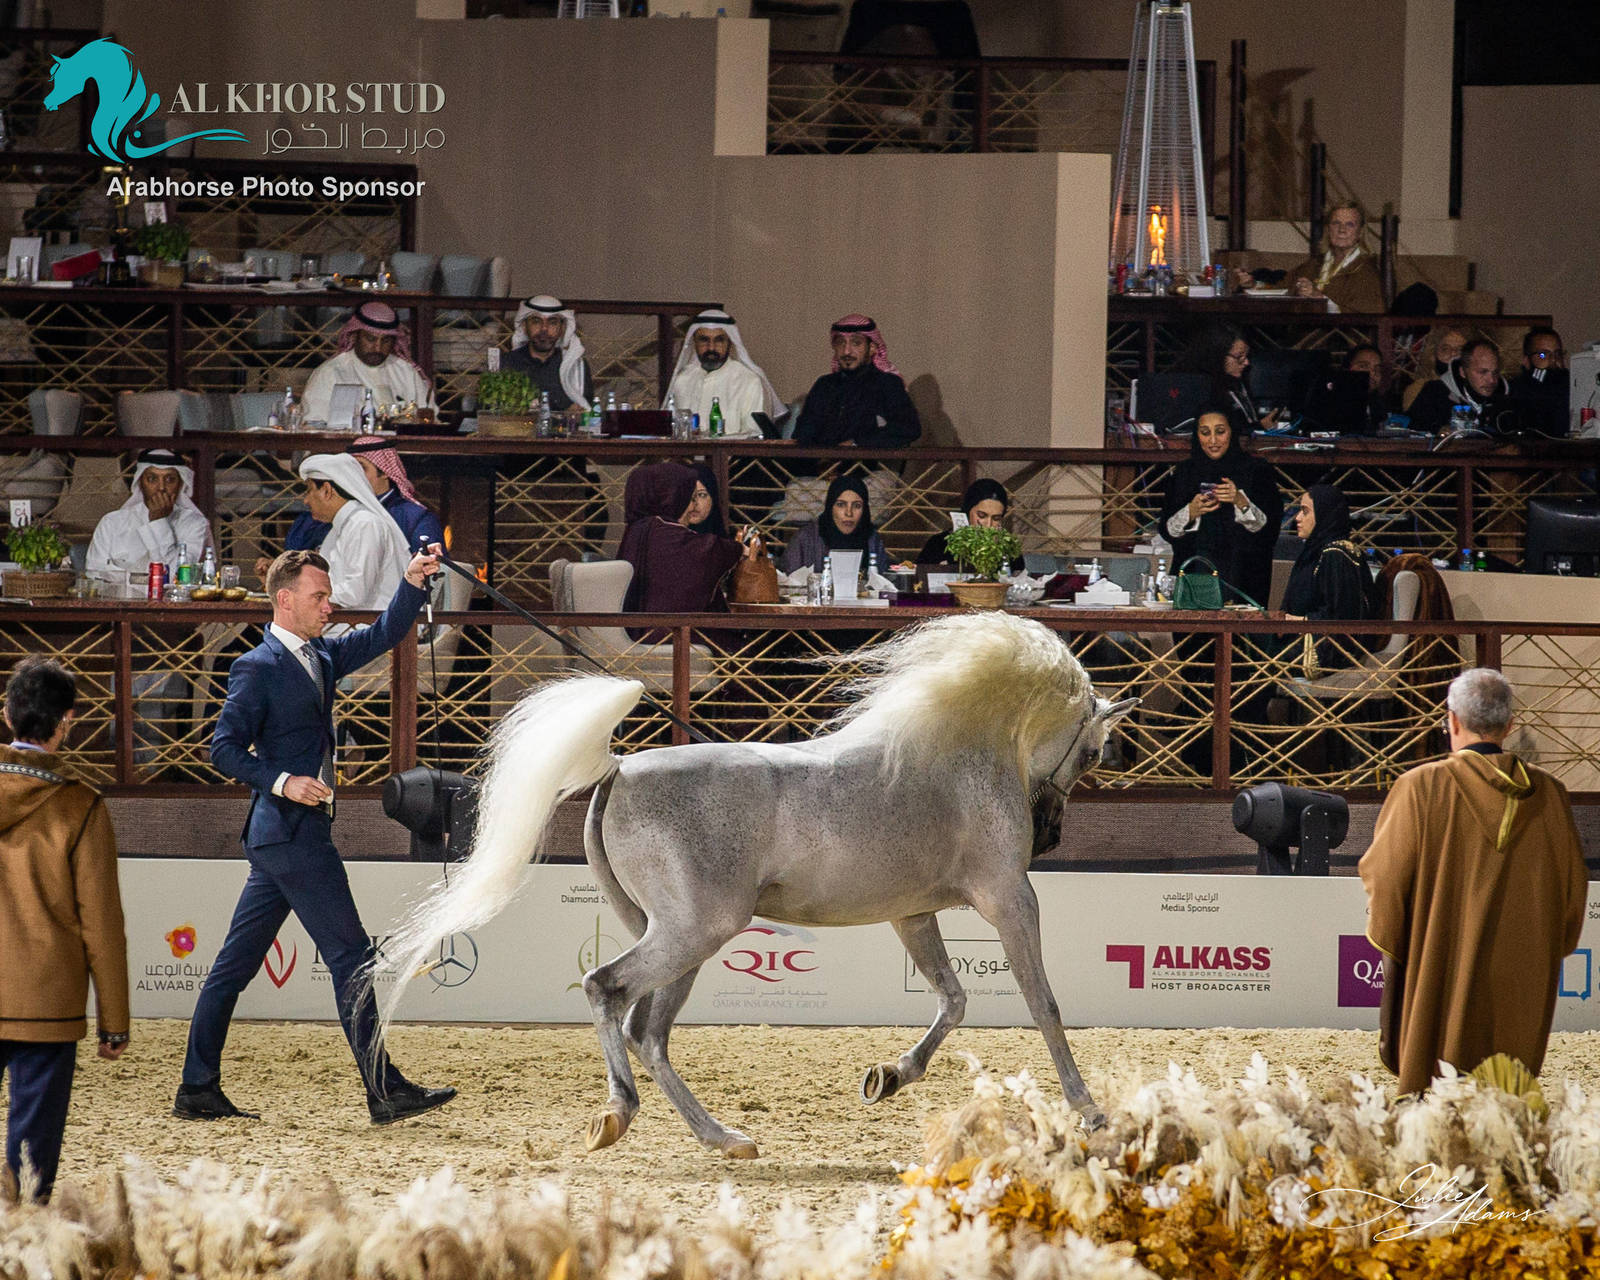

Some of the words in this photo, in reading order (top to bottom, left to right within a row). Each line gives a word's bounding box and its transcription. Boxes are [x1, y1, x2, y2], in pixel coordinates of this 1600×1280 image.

[561, 895, 599, 903] Diamond
[1161, 904, 1185, 912] Media
[1187, 904, 1220, 913] Sponsor
[1152, 945, 1271, 971] ALKASS
[722, 950, 819, 982] QIC
[1151, 982, 1182, 990] HOST
[1186, 982, 1271, 992] BROADCASTER
